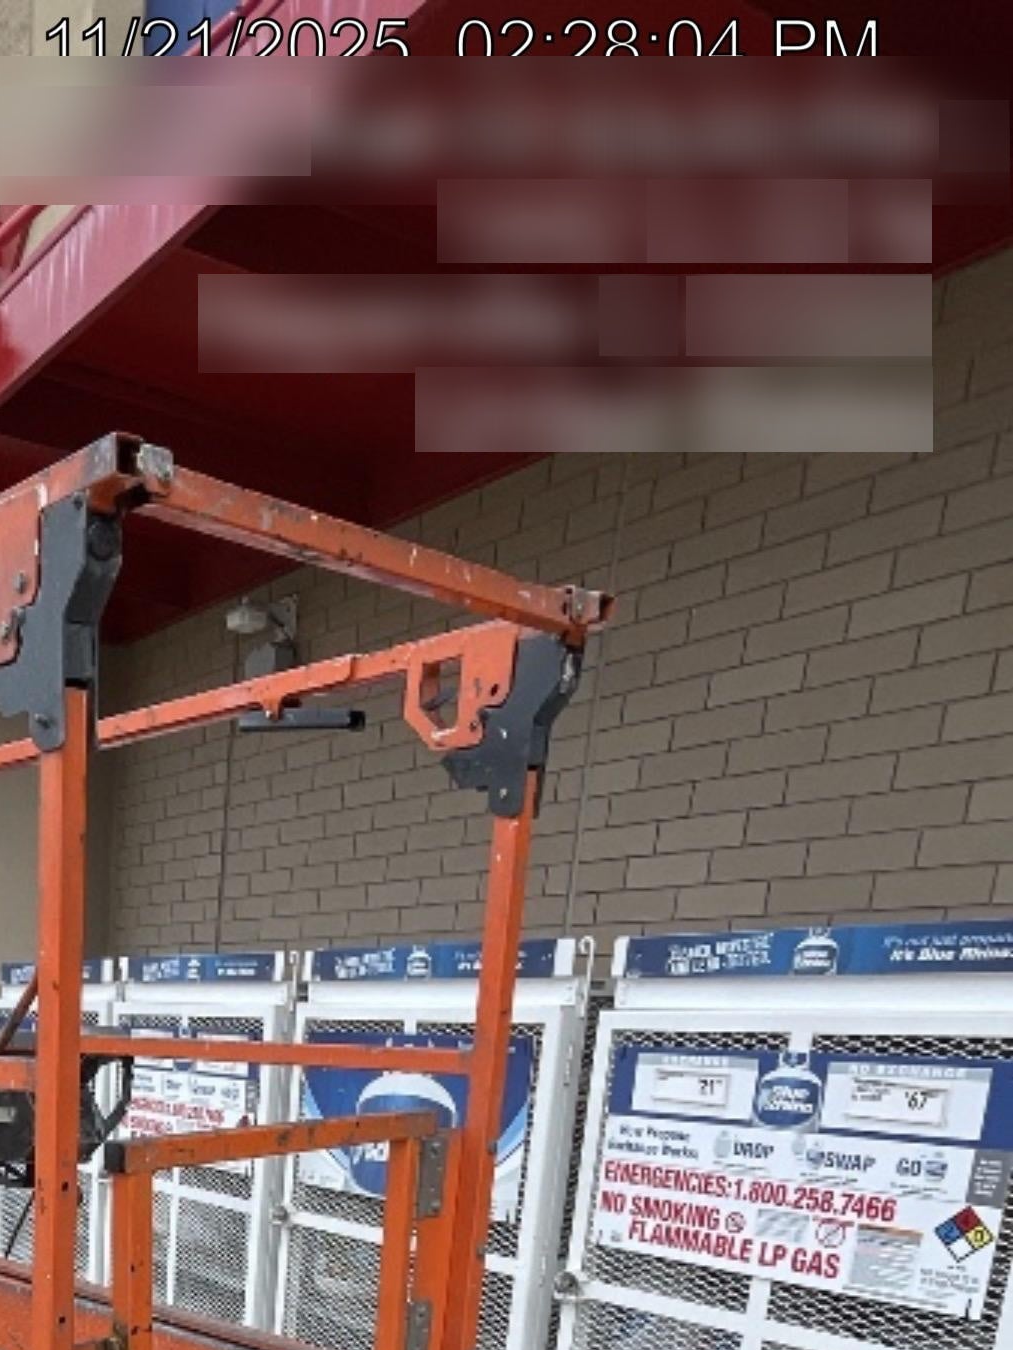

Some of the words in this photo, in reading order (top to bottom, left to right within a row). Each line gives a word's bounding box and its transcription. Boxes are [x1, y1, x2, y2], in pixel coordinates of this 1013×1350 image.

[733, 1141, 774, 1159] DROP
[823, 1151, 877, 1173] SWAP
[896, 1157, 922, 1176] GO
[600, 1190, 627, 1214] NO
[629, 1195, 721, 1231] SMOKING
[629, 1219, 753, 1264] FLAMMABLE
[757, 1241, 787, 1268] LP
[790, 1252, 840, 1280] GAS
